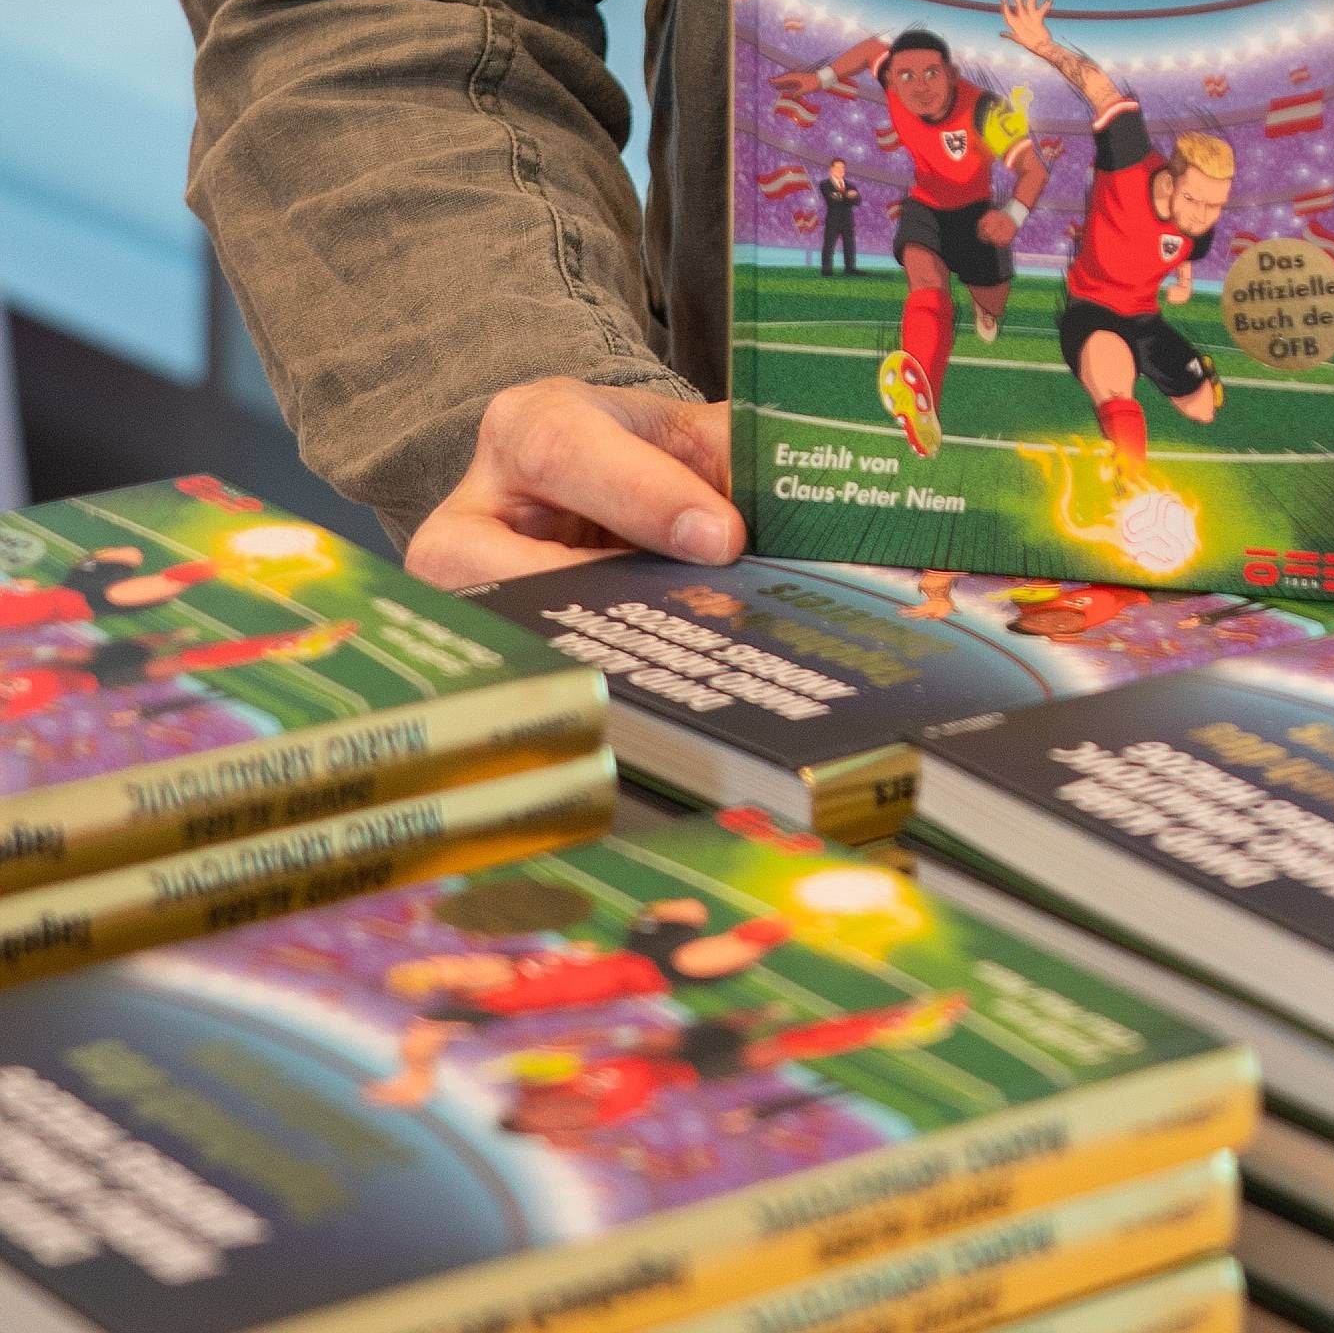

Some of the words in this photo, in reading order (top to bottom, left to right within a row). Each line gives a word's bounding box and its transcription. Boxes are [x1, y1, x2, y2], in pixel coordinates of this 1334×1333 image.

[1257, 251, 1304, 271] Das
[1234, 307, 1293, 332] Buch
[1268, 332, 1319, 358] ÖFB
[775, 443, 853, 470] Erzählt
[858, 455, 899, 474] von
[775, 475, 900, 507] Claus-Peter
[906, 485, 966, 513] Niem
